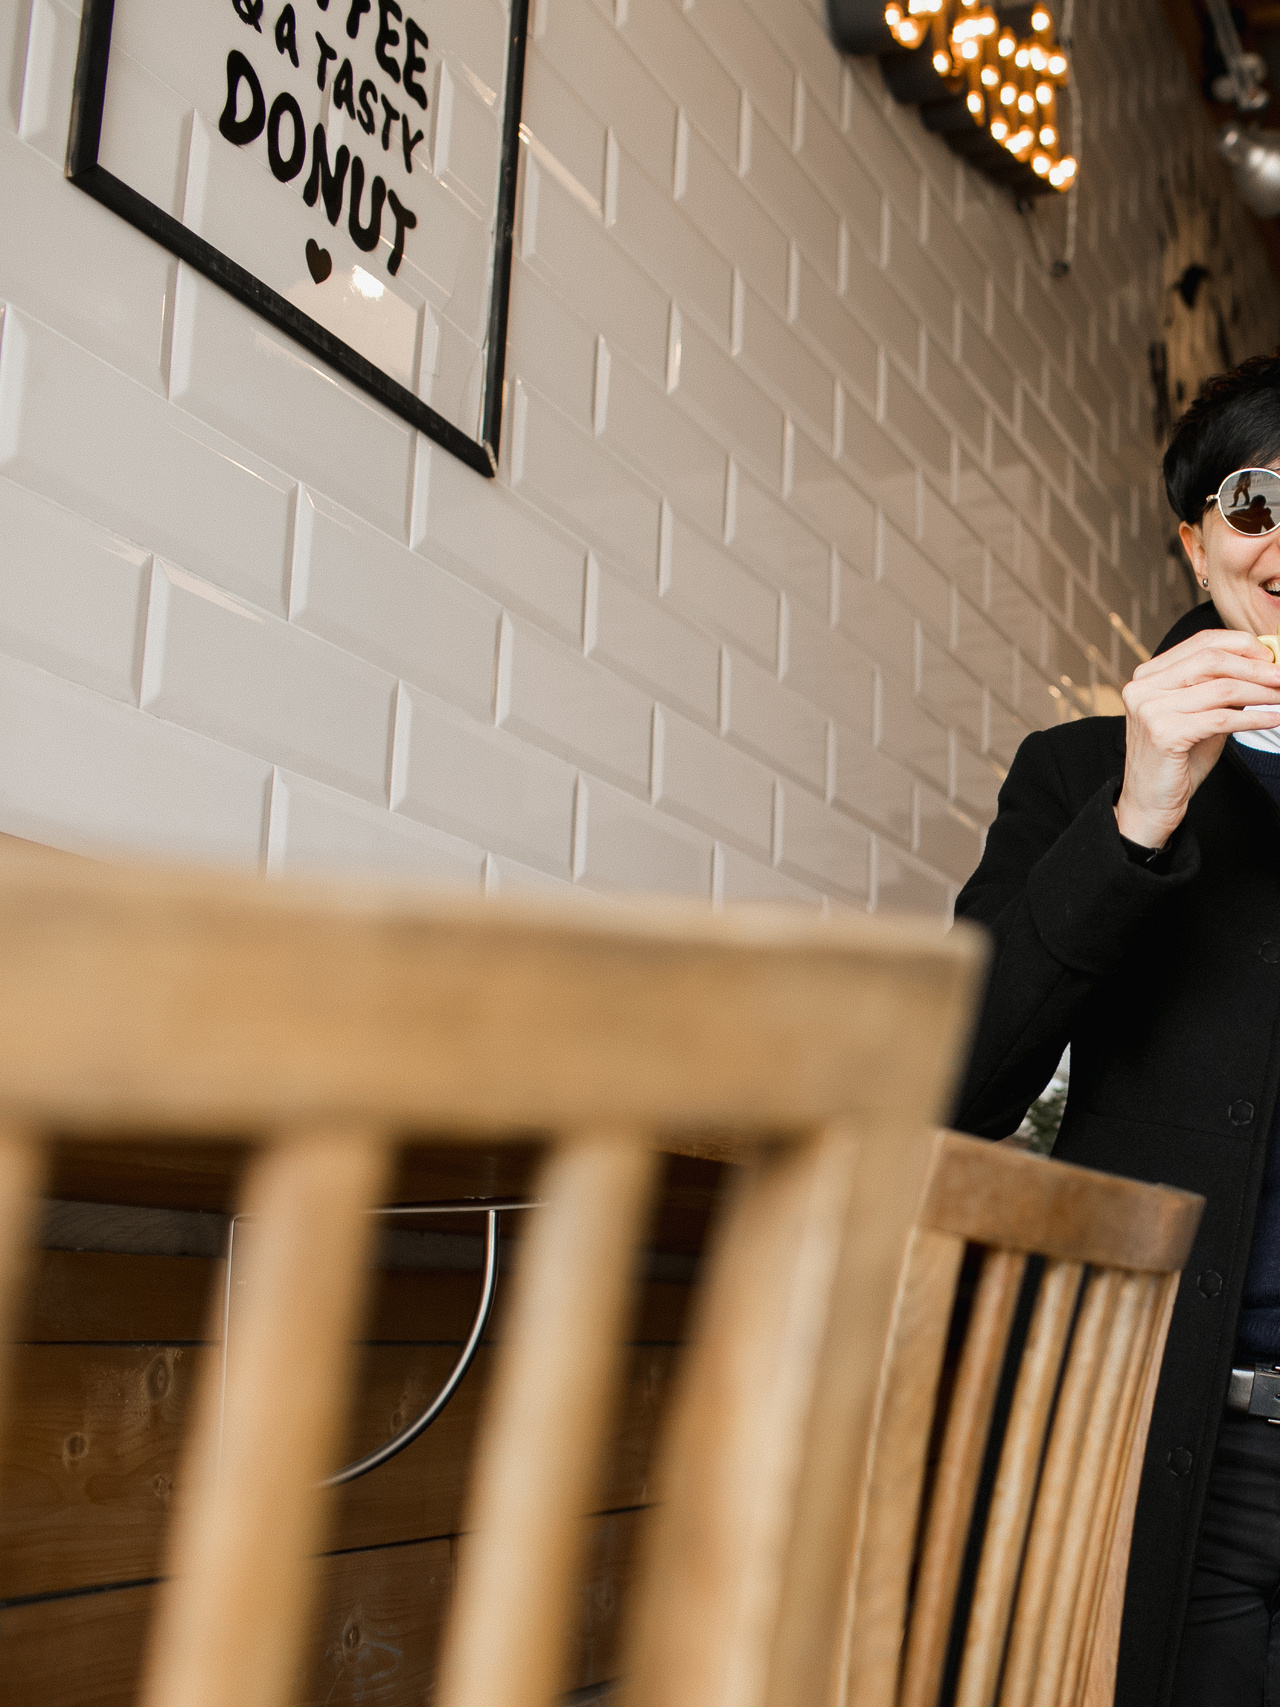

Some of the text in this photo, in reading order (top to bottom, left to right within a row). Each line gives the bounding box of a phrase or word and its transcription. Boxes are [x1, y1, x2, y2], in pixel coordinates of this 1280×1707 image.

[218, 49, 417, 277] DONUT
[275, 3, 299, 68] A
[315, 31, 424, 173] TASTY
